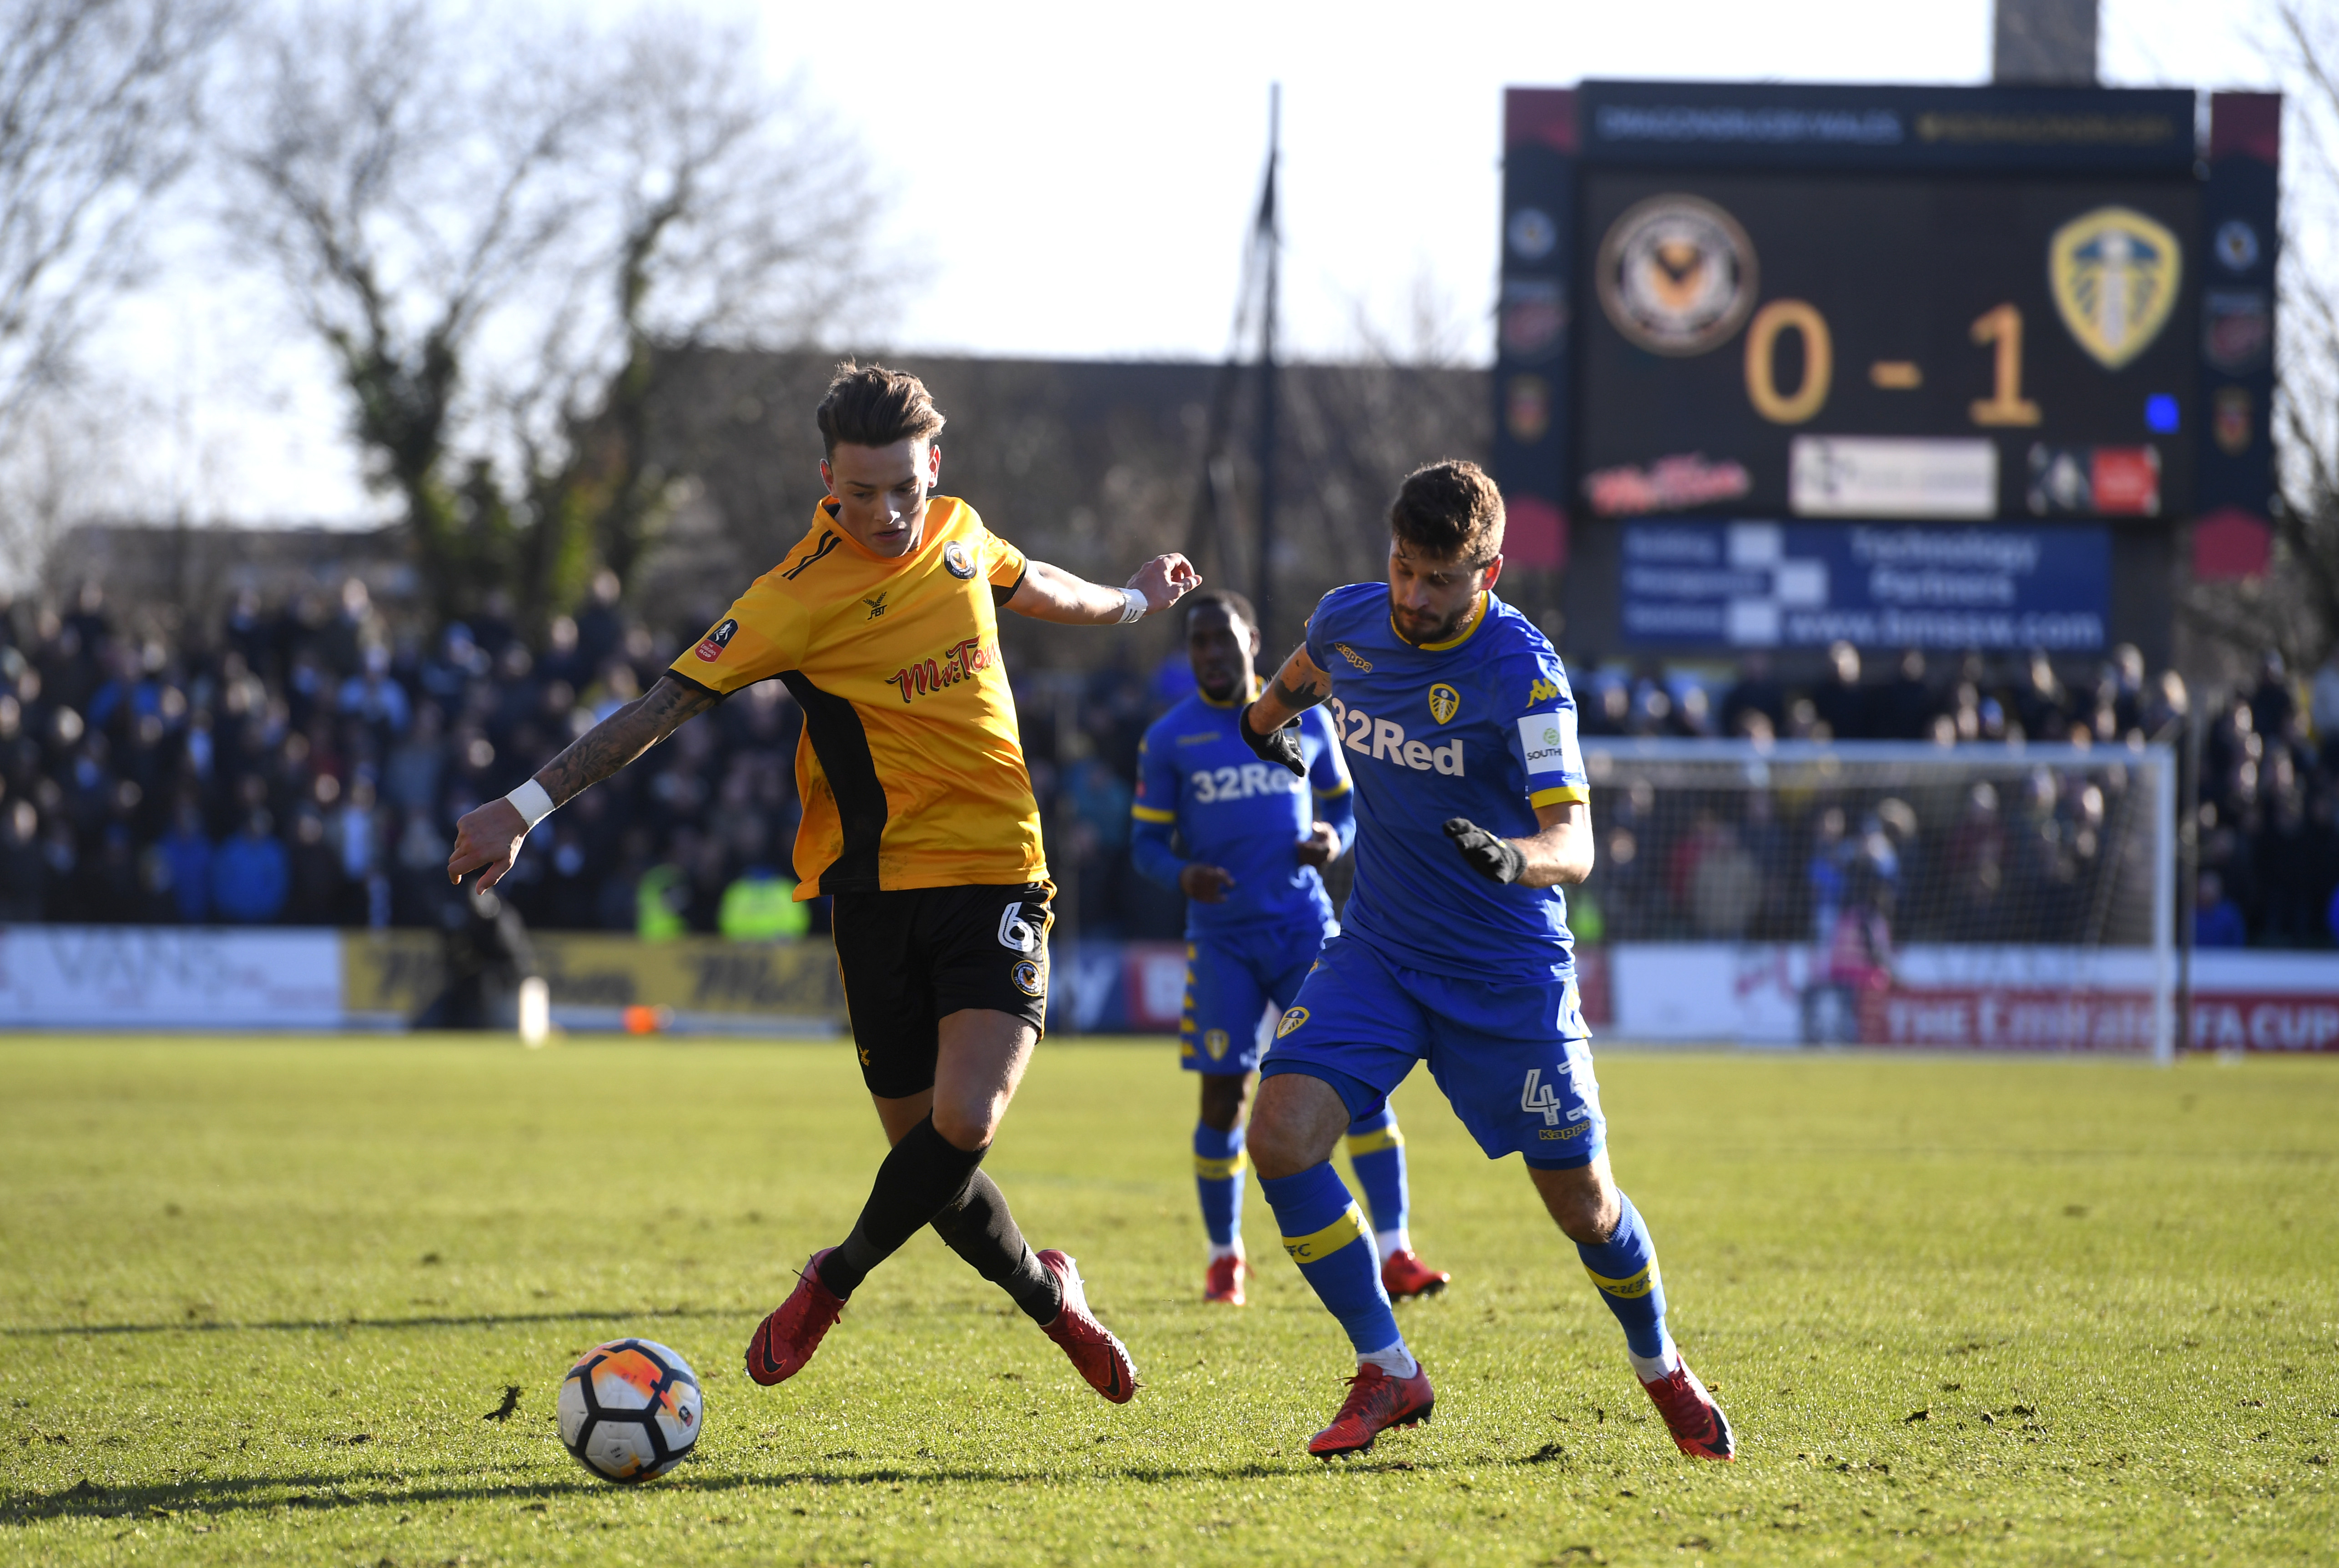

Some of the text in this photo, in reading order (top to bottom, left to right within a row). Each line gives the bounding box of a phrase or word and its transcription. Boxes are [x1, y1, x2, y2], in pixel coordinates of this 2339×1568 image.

[1745, 299, 1832, 423] 0
[1971, 305, 2041, 425] 1
[867, 604, 887, 620] FBT
[700, 643, 716, 656] Emirates
[1331, 697, 1465, 777] 32Red
[997, 901, 1034, 952] 6
[1977, 997, 2174, 1045] Emirate
[2196, 1003, 2244, 1048] FA
[1538, 1119, 1591, 1140] Kappa
[1284, 1243, 1311, 1256] FC
